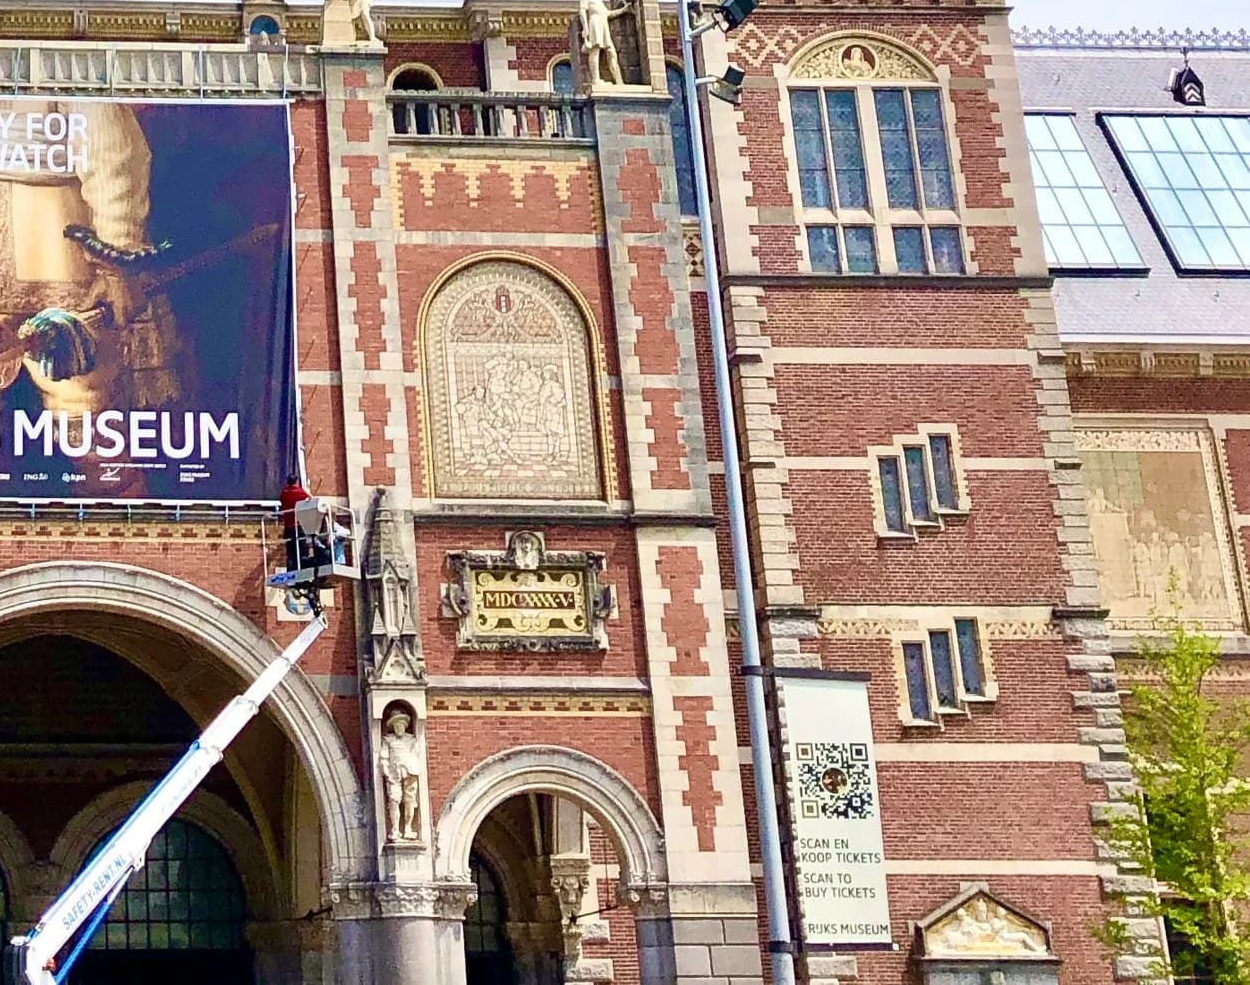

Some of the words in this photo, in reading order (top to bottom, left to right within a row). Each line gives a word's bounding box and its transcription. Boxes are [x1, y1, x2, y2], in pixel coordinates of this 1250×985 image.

[27, 112, 89, 142] FOR
[13, 409, 240, 460] MUSEUM
[800, 838, 830, 849] SCAN
[834, 838, 849, 849] EN
[801, 852, 832, 863] KOOP
[835, 852, 881, 864] TICKETS
[803, 873, 833, 884] SCAN
[837, 873, 852, 884] TO
[805, 887, 827, 898] BUY
[830, 887, 876, 899] TICKETS
[840, 923, 889, 935] MUSEUM
